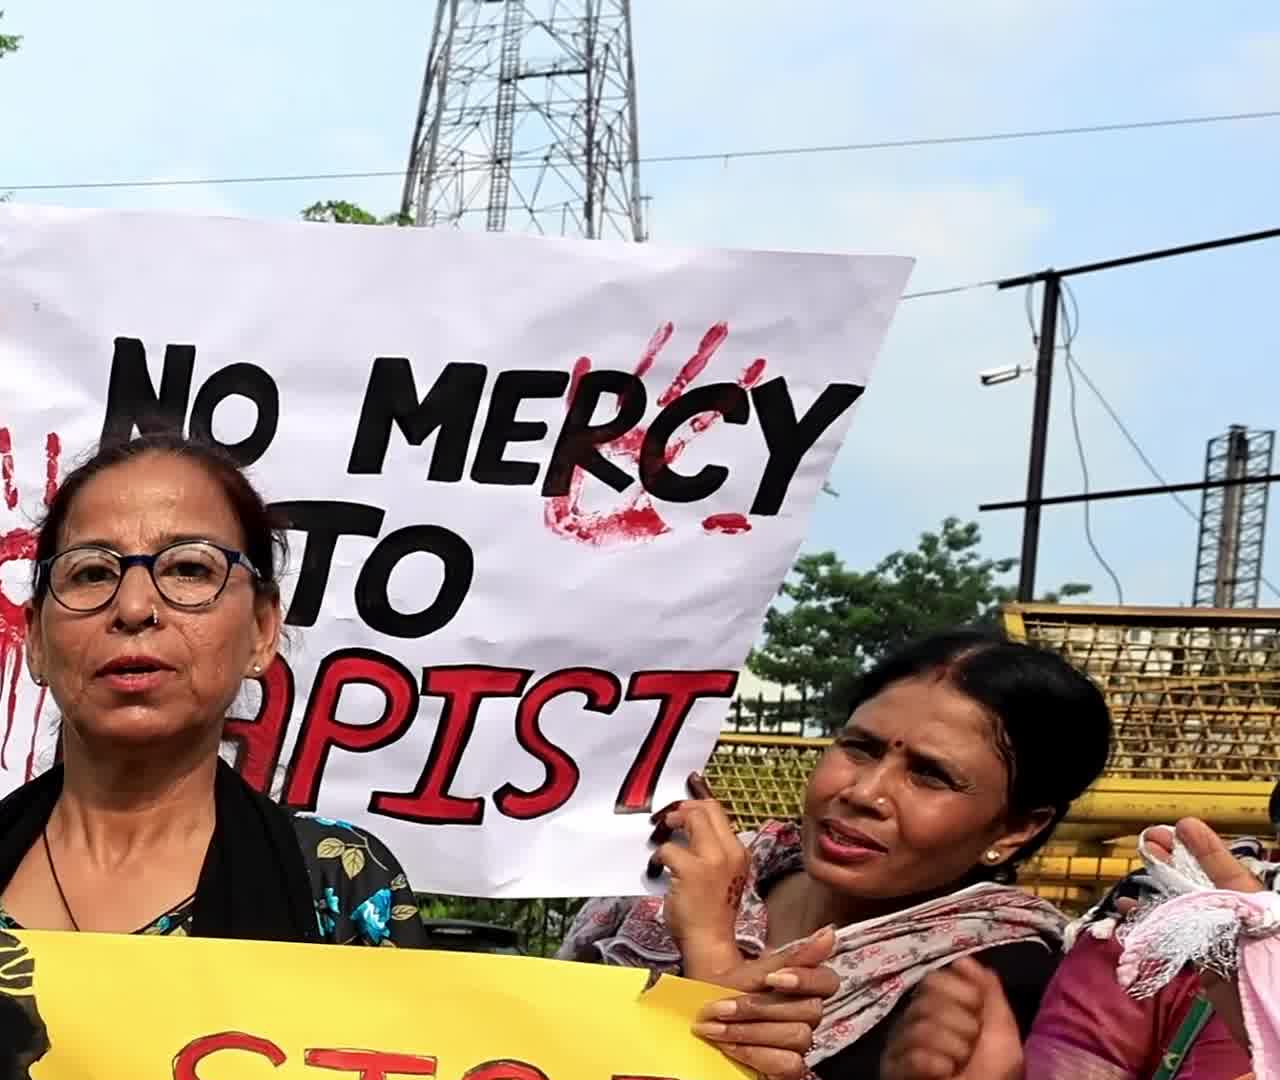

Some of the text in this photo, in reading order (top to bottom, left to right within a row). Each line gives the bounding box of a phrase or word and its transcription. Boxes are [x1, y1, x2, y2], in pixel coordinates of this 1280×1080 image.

[100, 337, 866, 517] NO MERCY
[262, 500, 475, 639] TO
[220, 646, 739, 826] APIST
